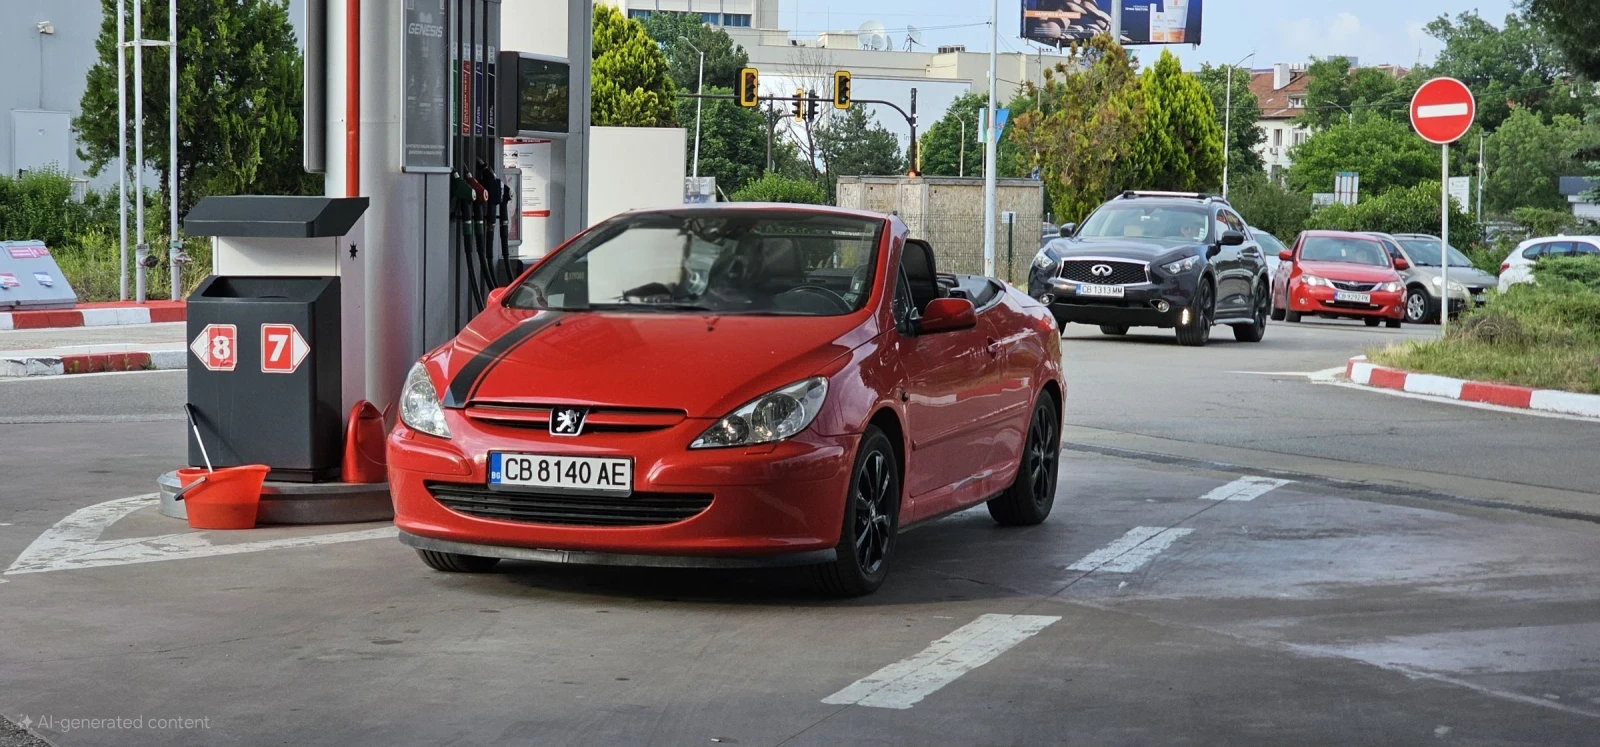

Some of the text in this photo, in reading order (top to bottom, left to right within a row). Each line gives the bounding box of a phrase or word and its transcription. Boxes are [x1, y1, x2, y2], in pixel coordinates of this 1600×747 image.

[408, 22, 443, 38] GENESIS
[1082, 285, 1123, 295] CB 1313 MM
[212, 335, 231, 360] 8
[268, 334, 289, 362] 7
[491, 471, 501, 479] BG
[505, 457, 626, 486] CB 8140 AE
